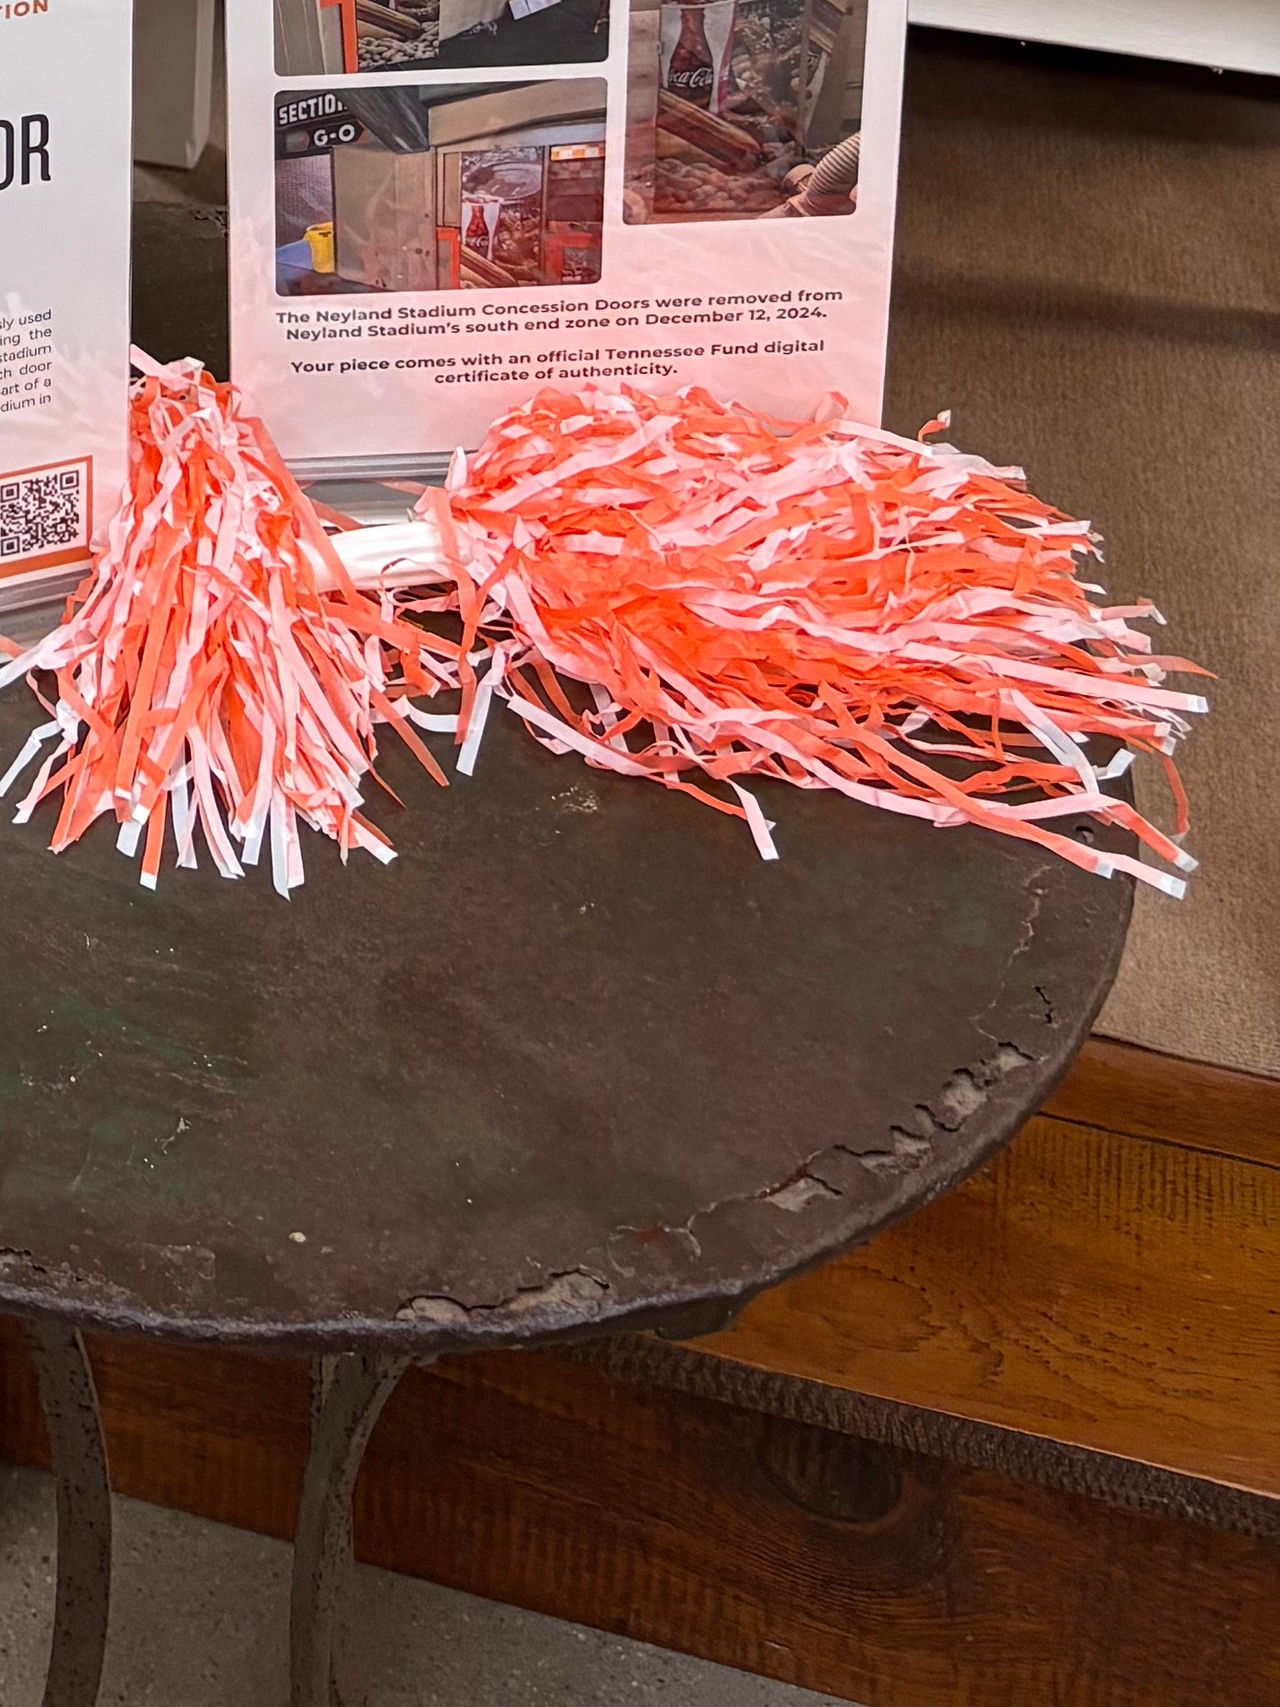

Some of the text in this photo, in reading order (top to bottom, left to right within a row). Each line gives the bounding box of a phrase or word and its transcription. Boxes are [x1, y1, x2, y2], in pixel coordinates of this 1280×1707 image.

[275, 288, 843, 325] The Neyland Stadium Concession Doors were removed from
[18, 308, 51, 326] used
[286, 305, 827, 343] Neyland Stadium's south end zone on December 12, 2024.
[28, 324, 52, 340] the
[290, 339, 824, 373] Your piece comes with an official Tennessee Fund digital
[19, 357, 52, 375] door
[434, 361, 678, 383] certificate of authenticity.
[24, 377, 39, 391] of
[43, 377, 51, 387] a
[39, 391, 51, 404] in
